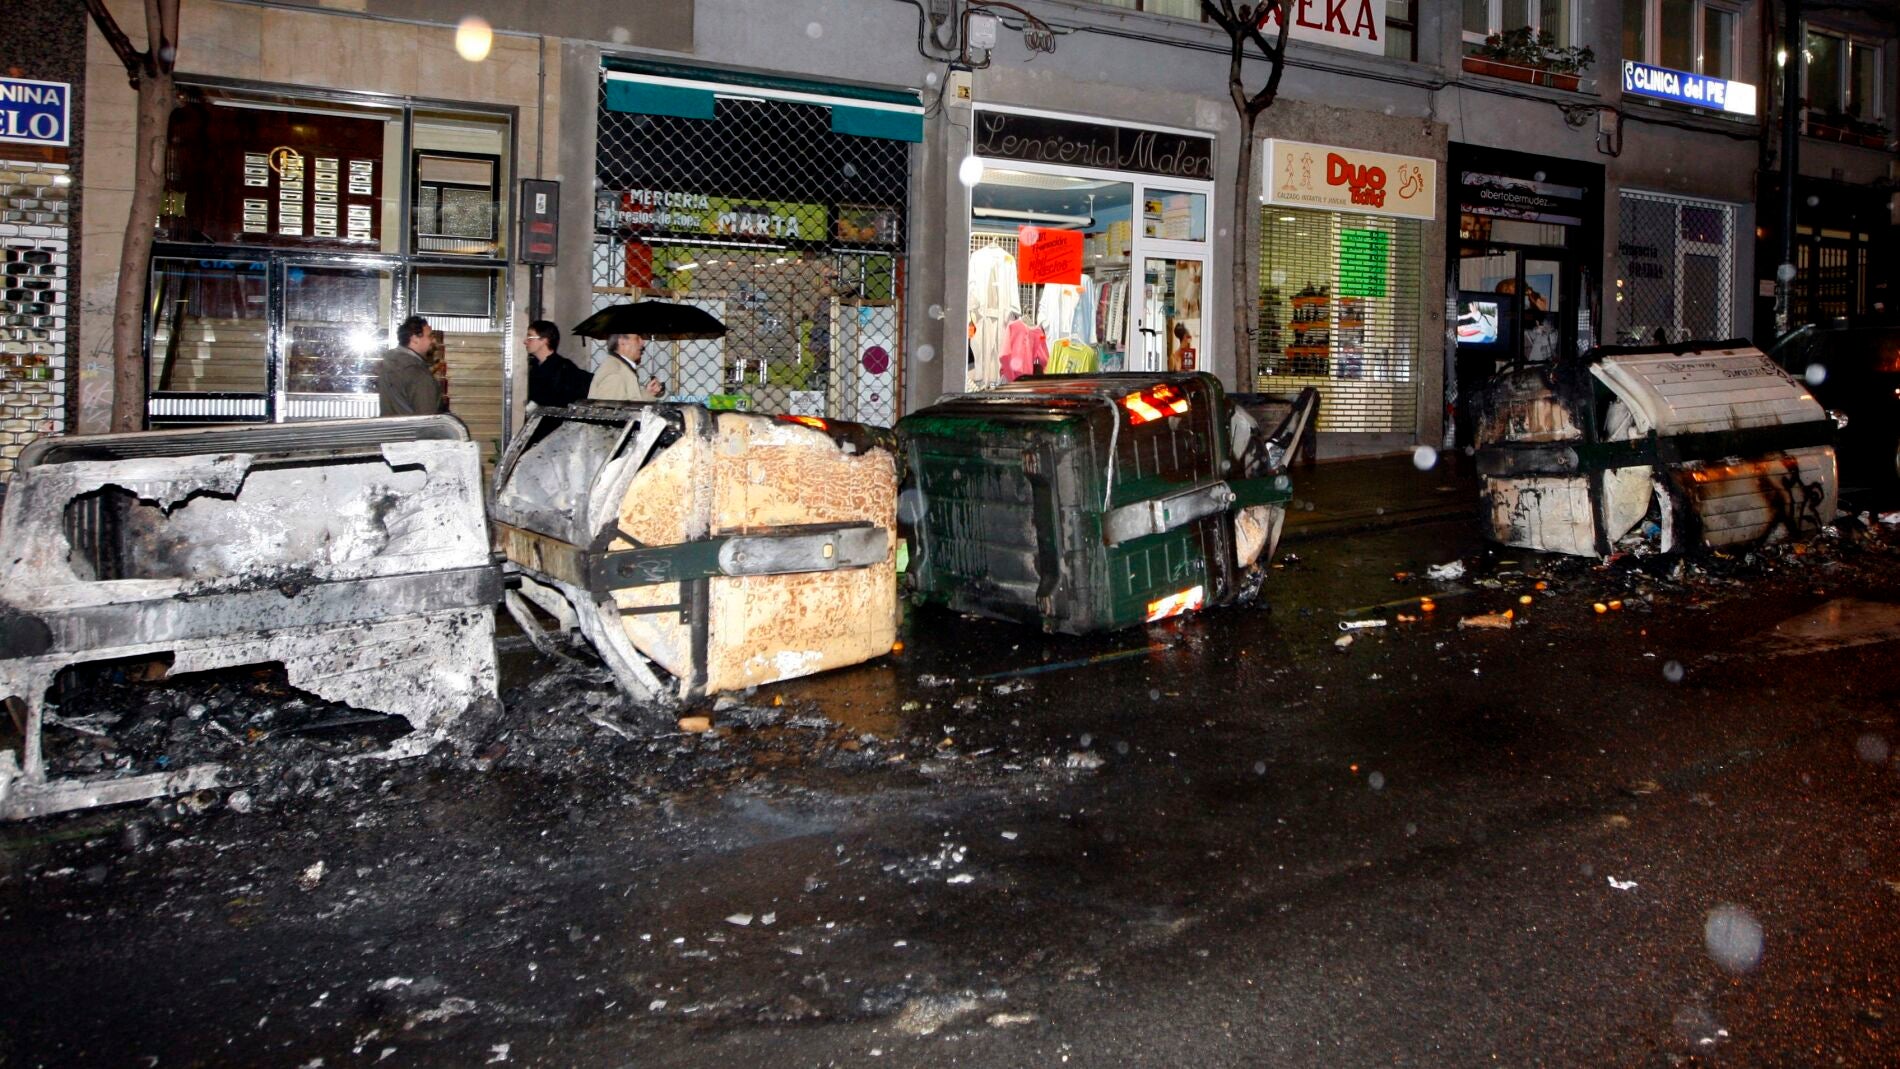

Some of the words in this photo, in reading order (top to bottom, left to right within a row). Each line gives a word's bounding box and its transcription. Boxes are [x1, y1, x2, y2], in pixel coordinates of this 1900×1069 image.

[1633, 66, 1681, 96] CLINICA
[1683, 77, 1703, 100] del
[718, 210, 800, 238] MARTA
